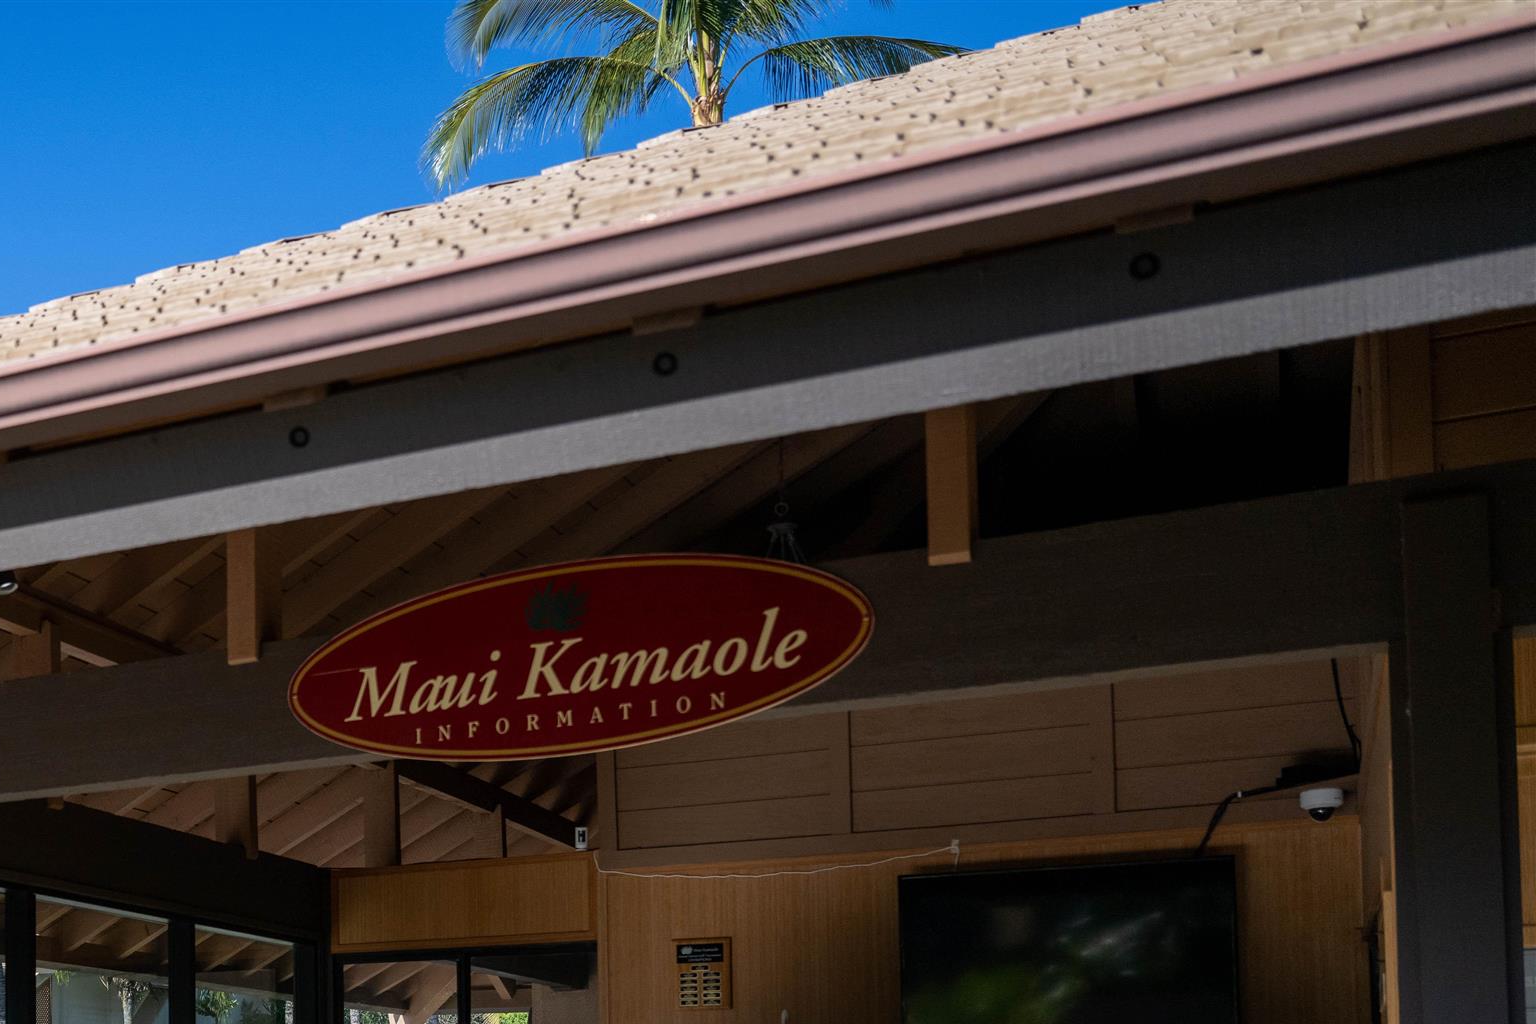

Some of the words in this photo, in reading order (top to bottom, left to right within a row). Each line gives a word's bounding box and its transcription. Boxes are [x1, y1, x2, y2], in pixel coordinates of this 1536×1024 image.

[343, 650, 501, 723] Maui
[516, 606, 809, 700] Kamaole
[415, 692, 726, 745] INFORMATION
